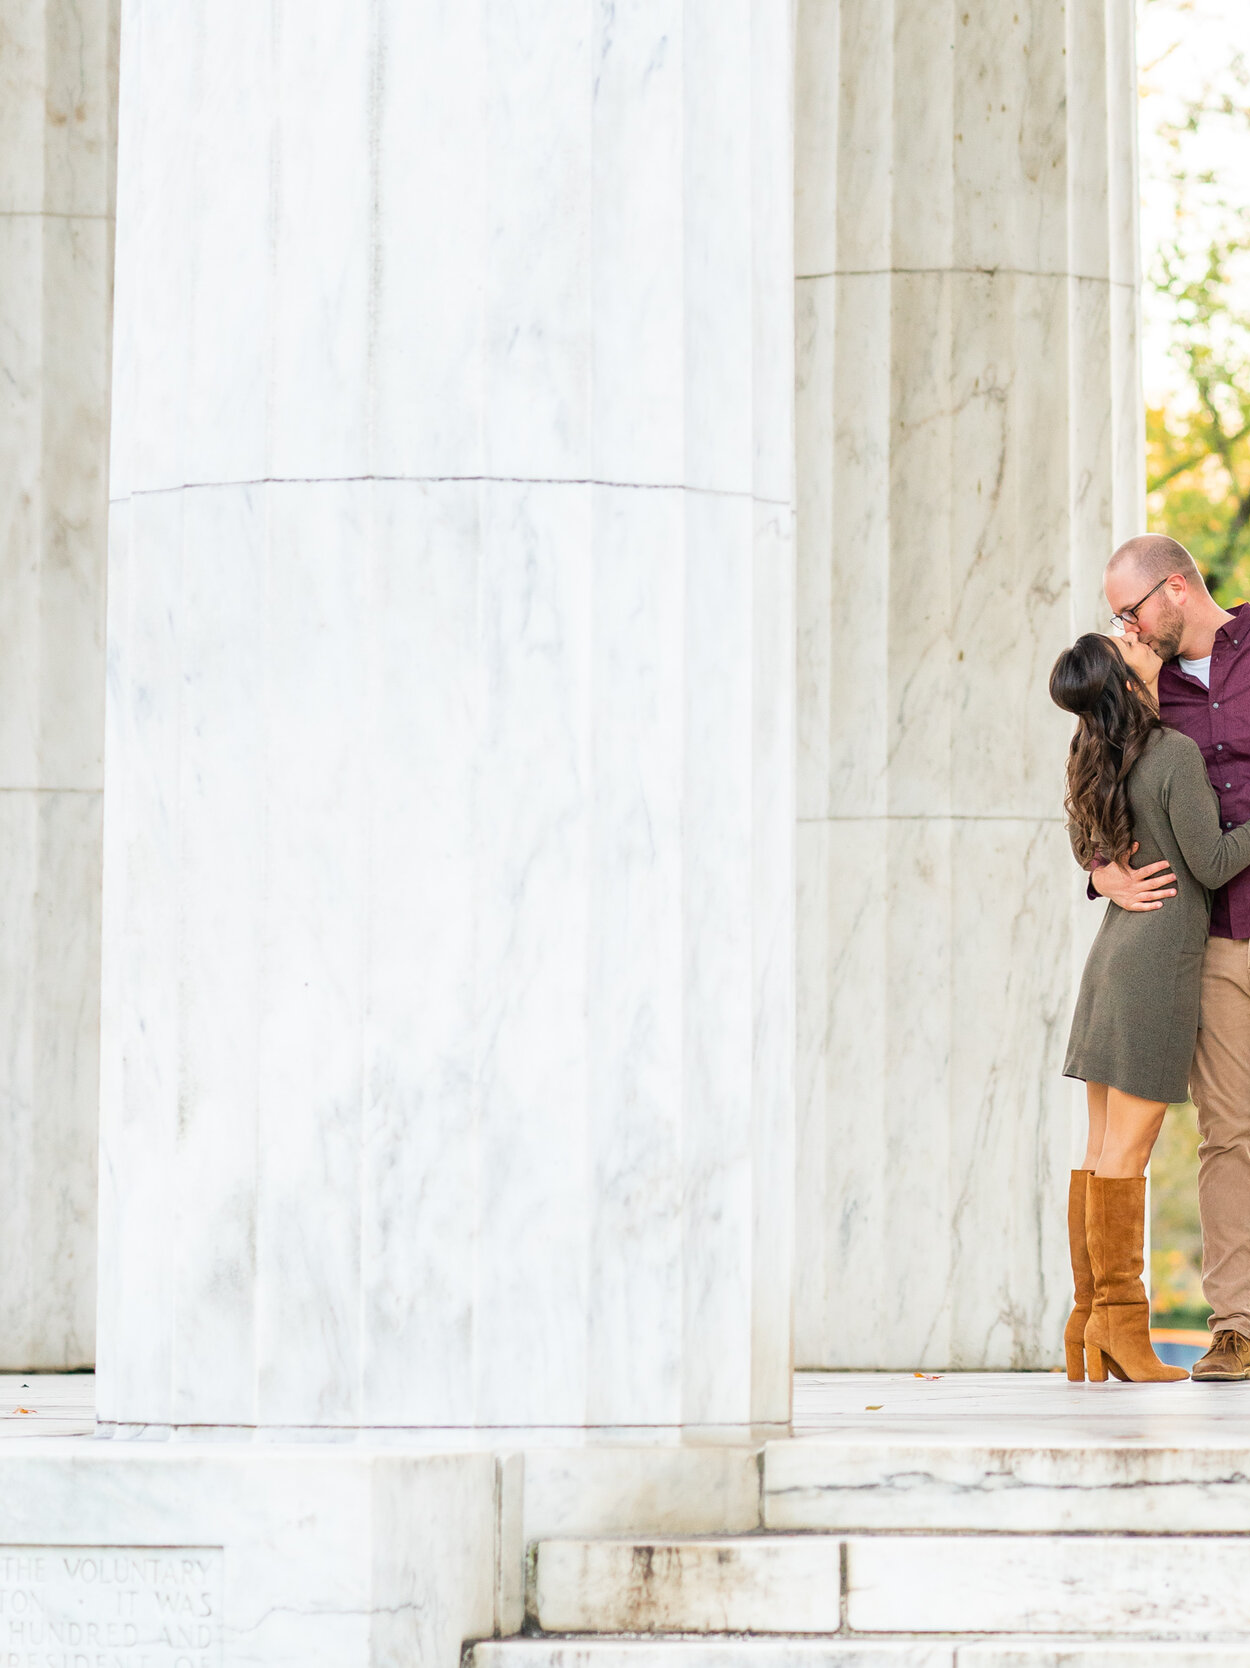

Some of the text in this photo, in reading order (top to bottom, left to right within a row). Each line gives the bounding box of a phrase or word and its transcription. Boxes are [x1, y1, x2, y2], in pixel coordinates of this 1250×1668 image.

[2, 1557, 213, 1585] THE VOLUNTARY
[116, 1590, 139, 1617] IT
[154, 1590, 213, 1618] WAS
[9, 1620, 213, 1650] HUNDRED AND
[0, 1651, 151, 1668] RESIDENT
